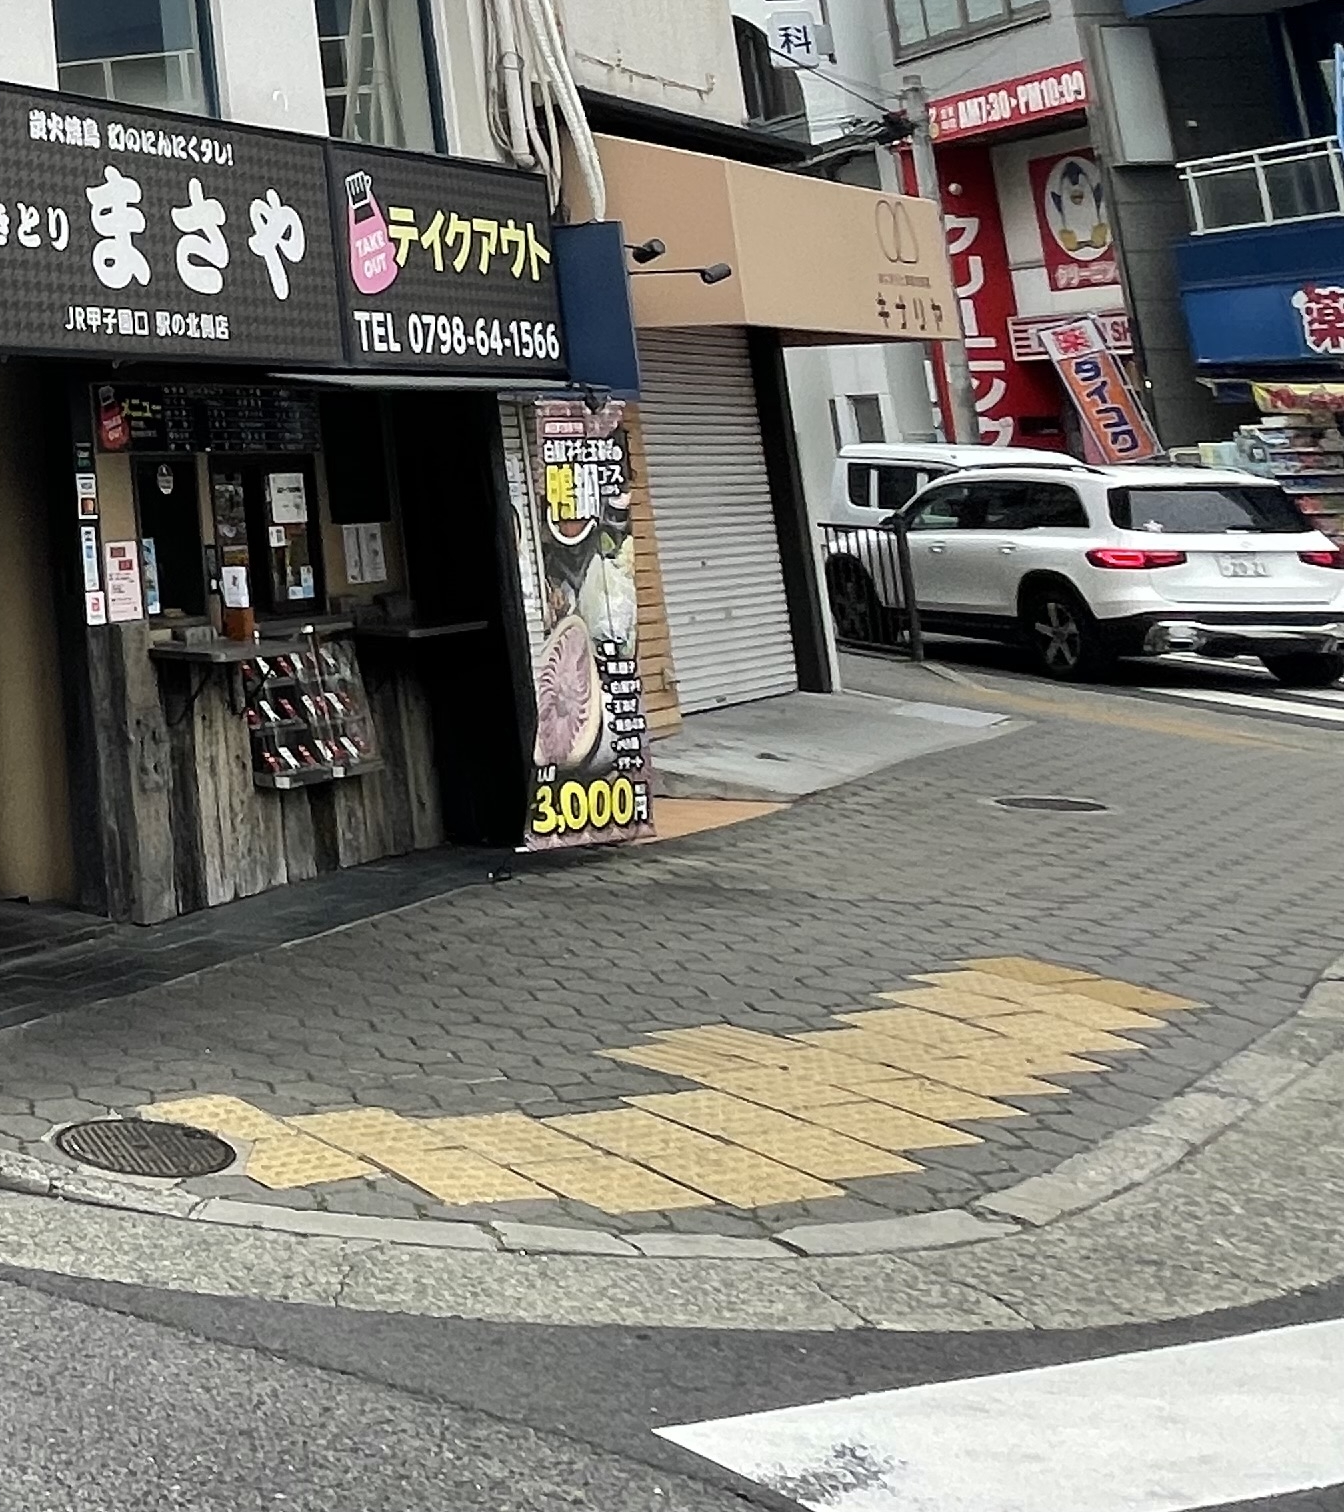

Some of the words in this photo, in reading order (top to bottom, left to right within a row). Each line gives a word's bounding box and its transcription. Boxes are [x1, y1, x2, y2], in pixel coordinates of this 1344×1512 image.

[29, 110, 100, 149] 炭火焼鳥
[87, 165, 306, 300] まさや
[355, 230, 387, 257] TAKE
[388, 206, 551, 282] テイクアウト
[364, 253, 387, 278] OUT
[353, 310, 402, 353] TEL
[408, 313, 560, 360] 0798-64-1566
